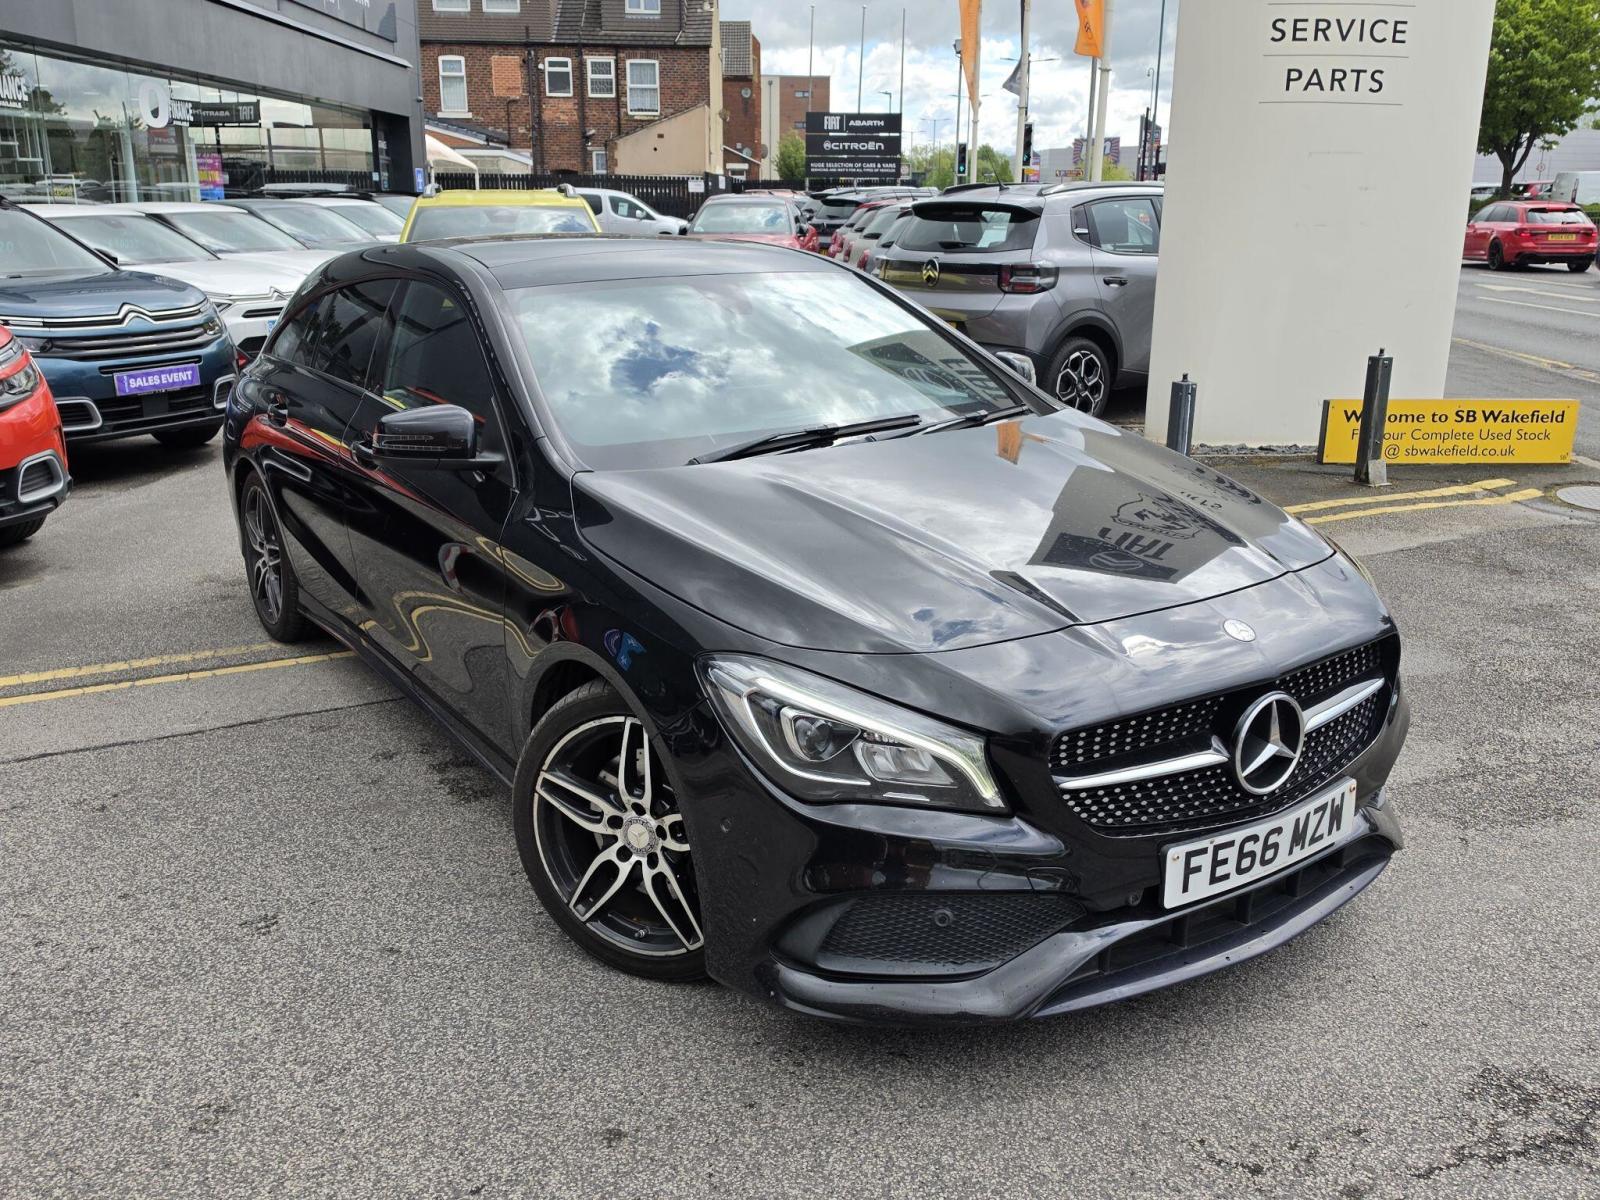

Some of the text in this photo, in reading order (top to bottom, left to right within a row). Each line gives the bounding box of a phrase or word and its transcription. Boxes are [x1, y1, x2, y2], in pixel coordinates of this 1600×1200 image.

[1270, 18, 1408, 43] SERVICE
[1285, 68, 1385, 93] PARTS
[824, 116, 840, 130] FIAT
[129, 371, 192, 388] SALES EVENT
[1344, 410, 1565, 423] Wome to SB Wakefield
[1411, 429, 1474, 443] Complete
[1479, 429, 1511, 440] Used
[1516, 429, 1551, 440] Stock
[1385, 444, 1515, 459] @ sbwakefield.co.uk
[1182, 791, 1345, 894] FE66 MZW
